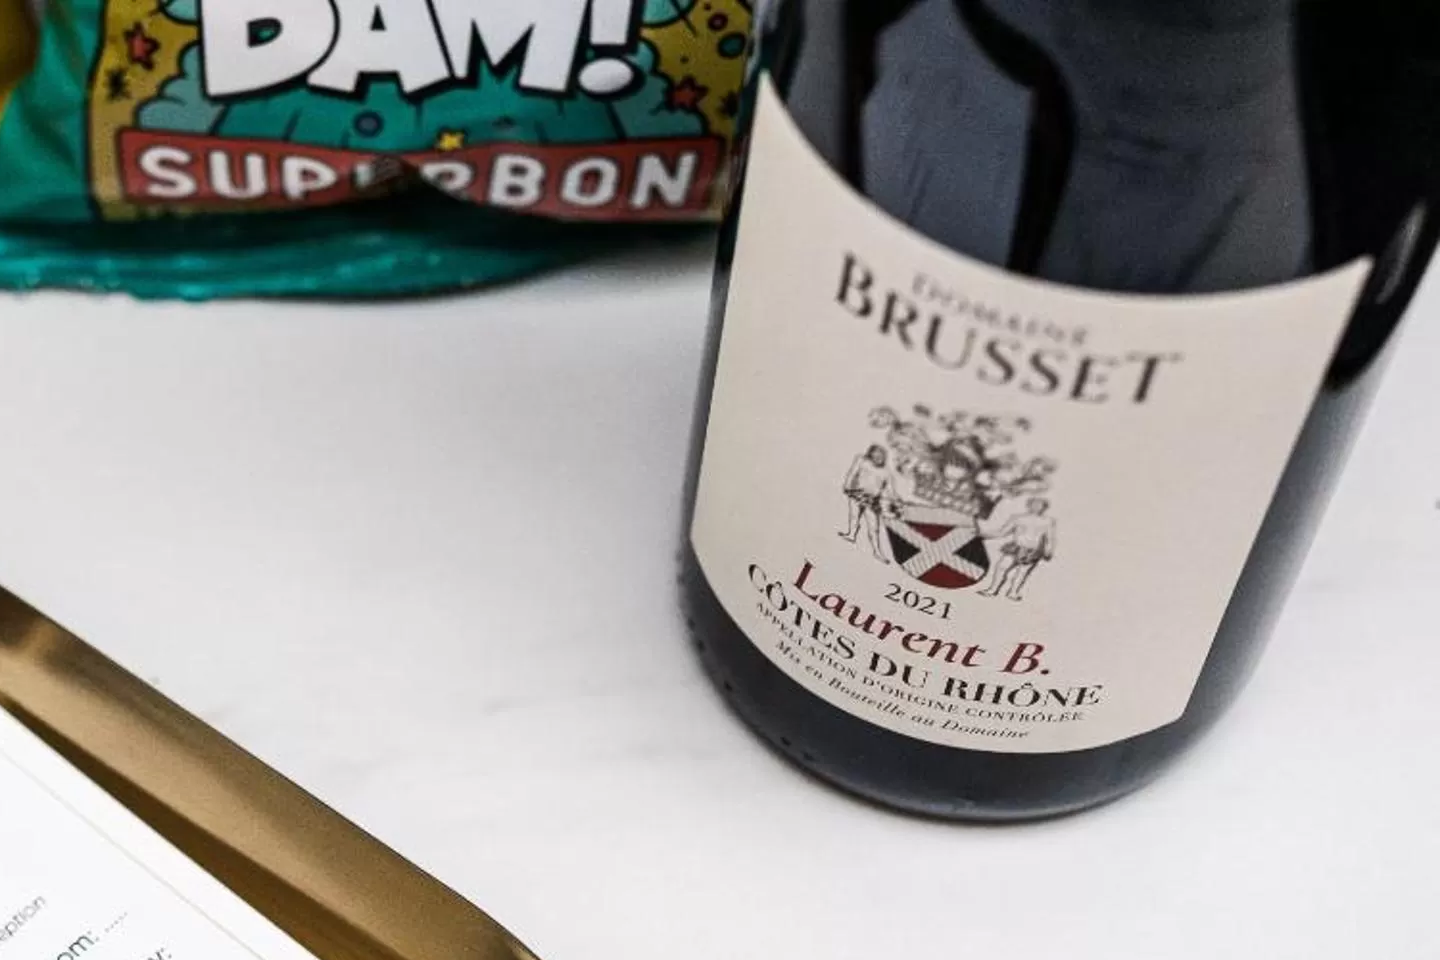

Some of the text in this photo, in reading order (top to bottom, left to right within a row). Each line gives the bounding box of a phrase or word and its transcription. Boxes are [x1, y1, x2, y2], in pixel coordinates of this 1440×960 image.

[835, 250, 1186, 404] BRUSSET
[747, 563, 1105, 709] CÔTES DU RHÔNE
[793, 558, 1051, 676] Laurent B.
[883, 582, 953, 621] 2021
[804, 664, 824, 681] en
[910, 713, 936, 729] au
[940, 718, 1031, 740] Domaine
